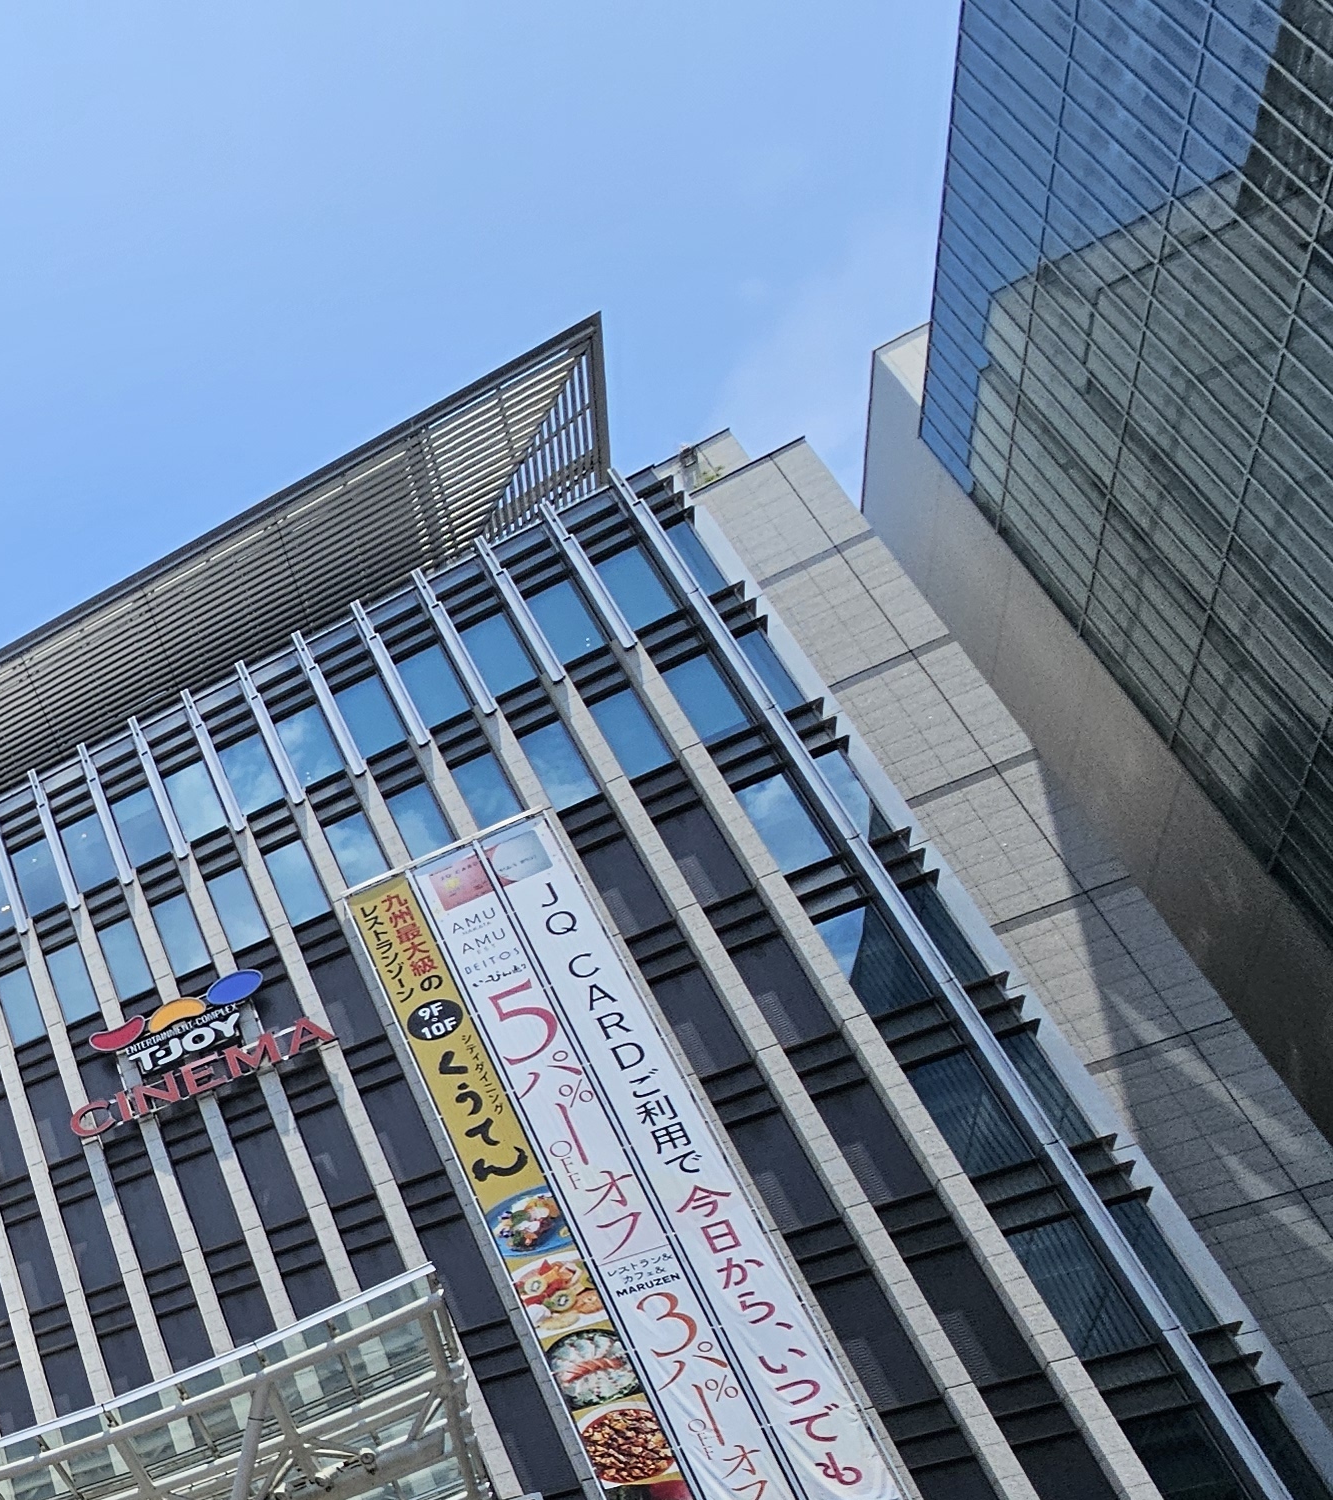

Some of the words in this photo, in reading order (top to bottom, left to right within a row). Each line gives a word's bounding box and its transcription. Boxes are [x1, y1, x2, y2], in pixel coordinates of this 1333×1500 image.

[453, 907, 496, 934] AMU
[541, 882, 578, 936] JQ
[360, 904, 415, 1004] レストランゾーン
[381, 894, 443, 992] 九州最大級の
[463, 928, 506, 954] AMU
[464, 947, 520, 975] DEITOS
[418, 1001, 443, 1020] 9F
[421, 1017, 457, 1040] 10F
[70, 1016, 336, 1138] CINEMA
[461, 1034, 504, 1115] シティダイニング
[438, 1050, 528, 1182] くうてん
[615, 1272, 681, 1298] MARUZEN
